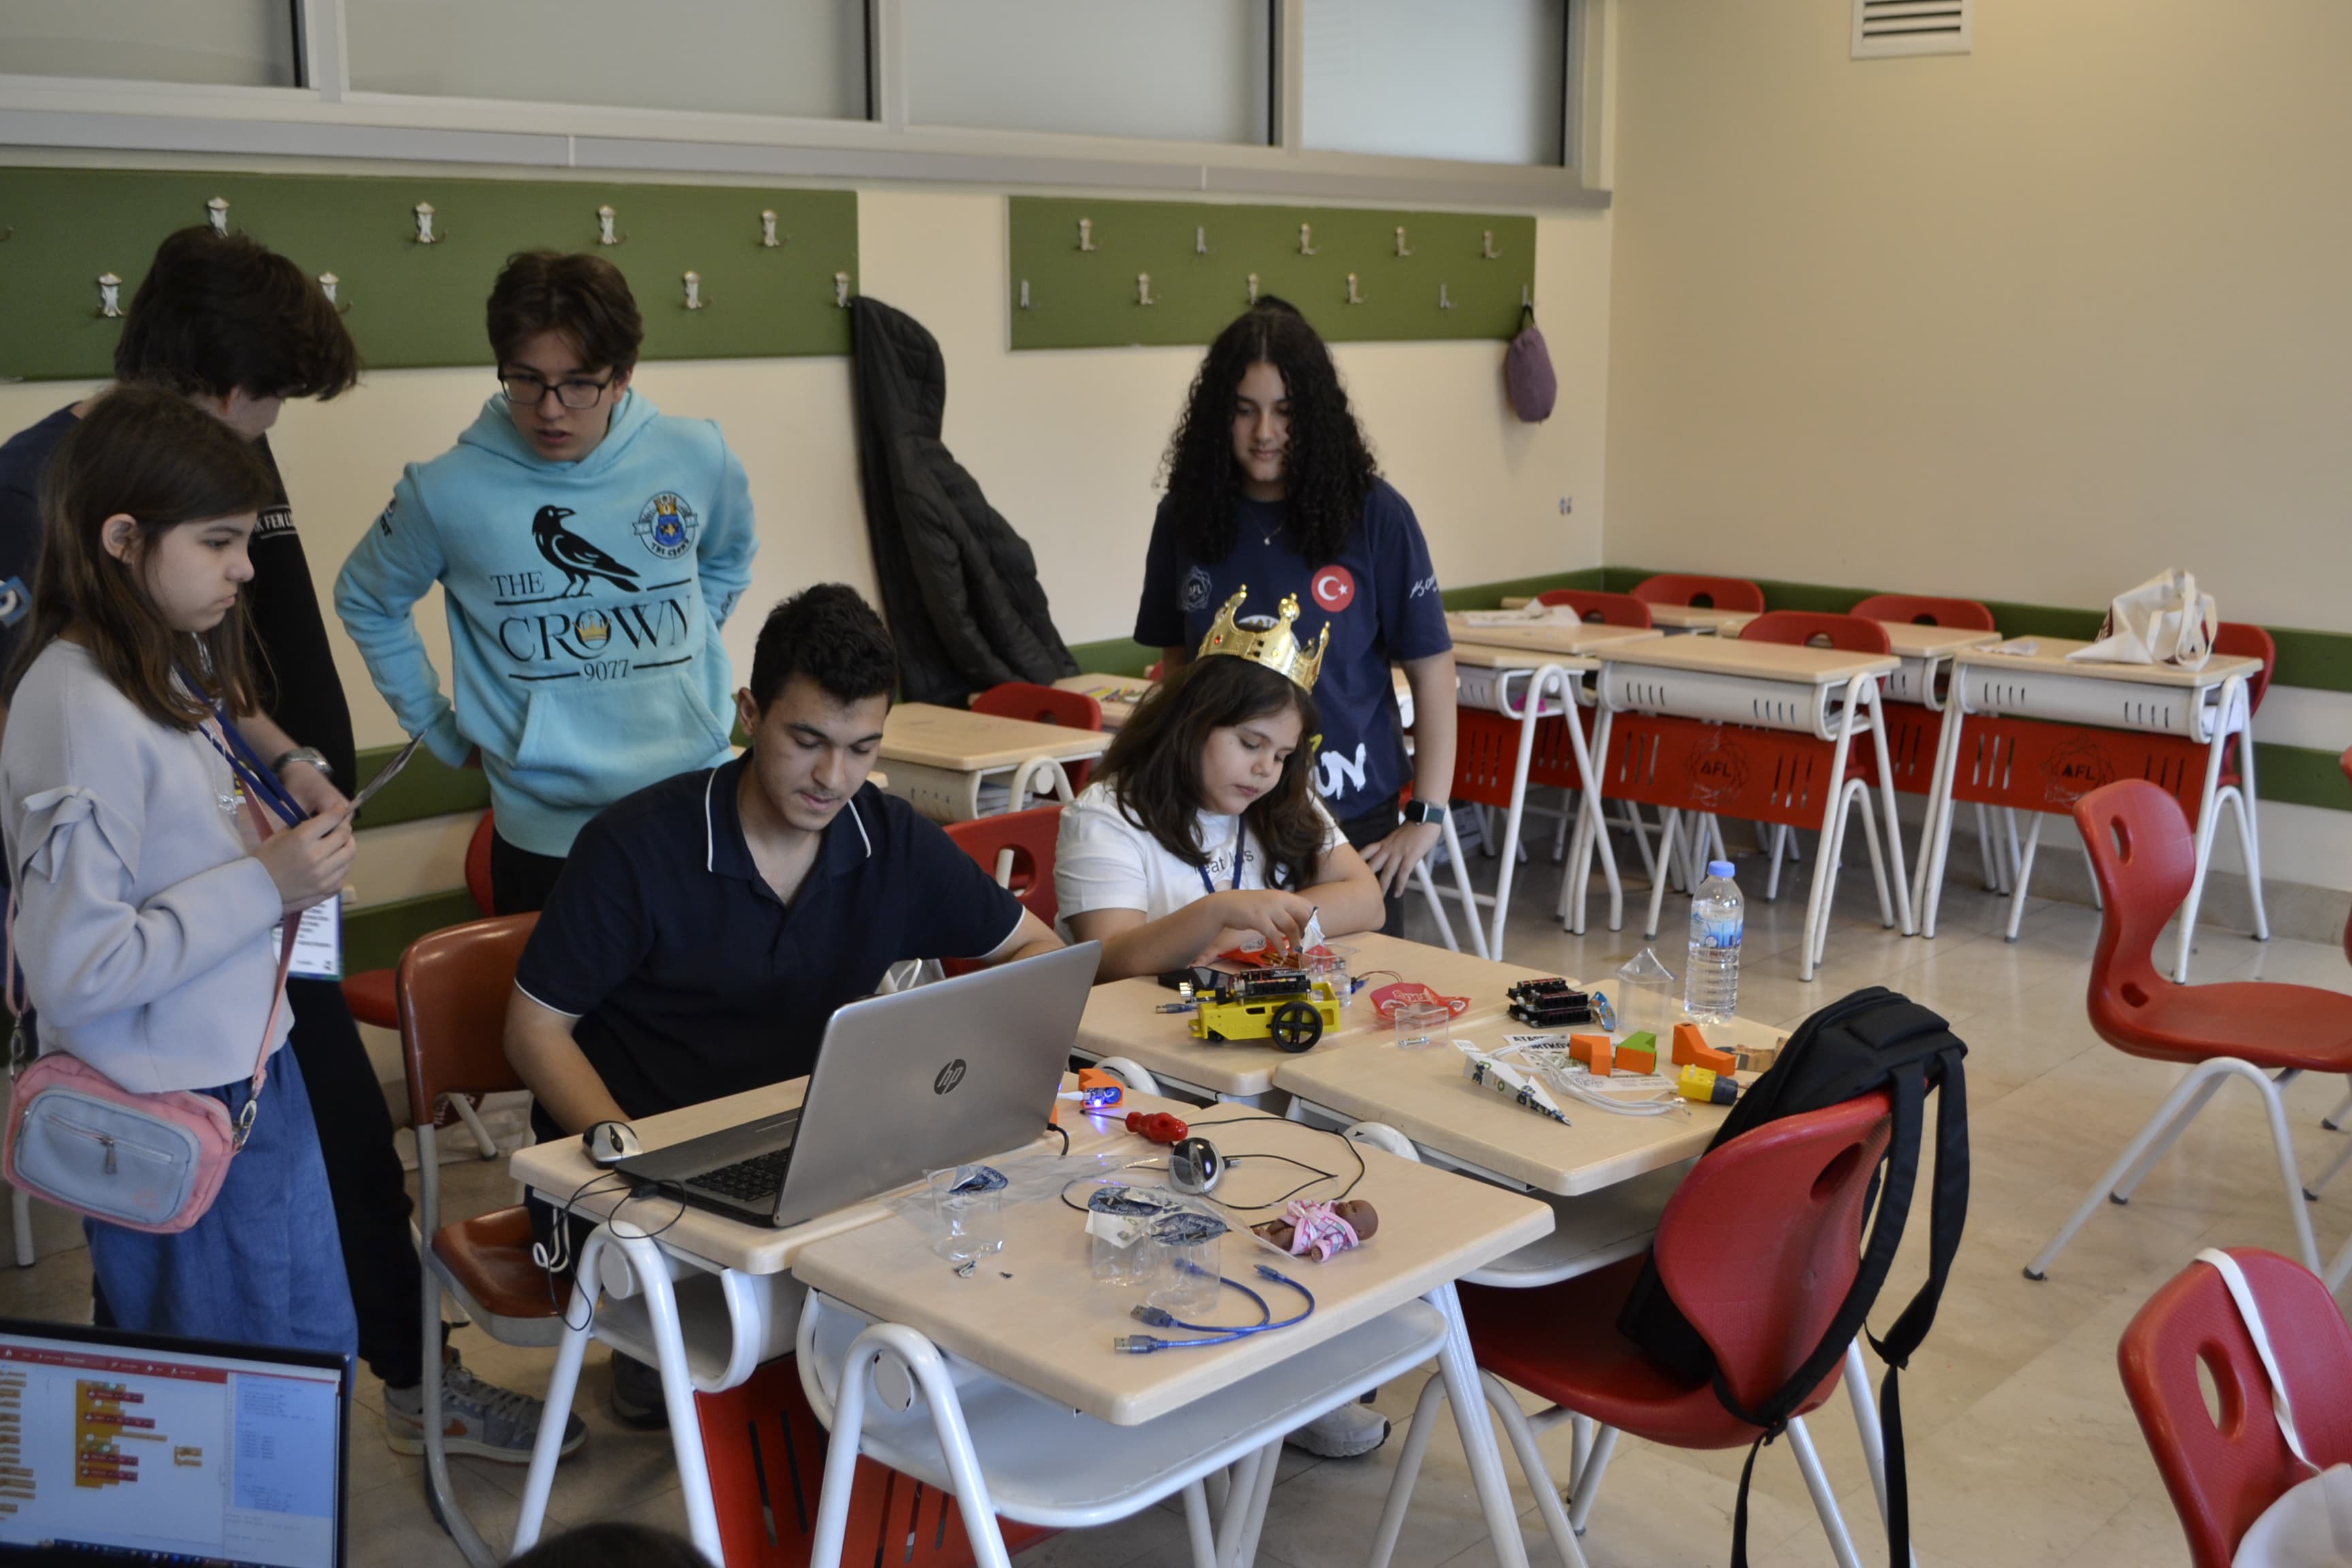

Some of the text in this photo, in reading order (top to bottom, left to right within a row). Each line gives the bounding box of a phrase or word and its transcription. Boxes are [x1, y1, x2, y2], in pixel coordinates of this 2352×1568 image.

[489, 570, 545, 597] THE
[498, 595, 691, 662] CROWN
[584, 659, 629, 681] 9077
[1700, 760, 1732, 778] AFL
[2061, 763, 2095, 781] AFL
[936, 1060, 965, 1094] hp
